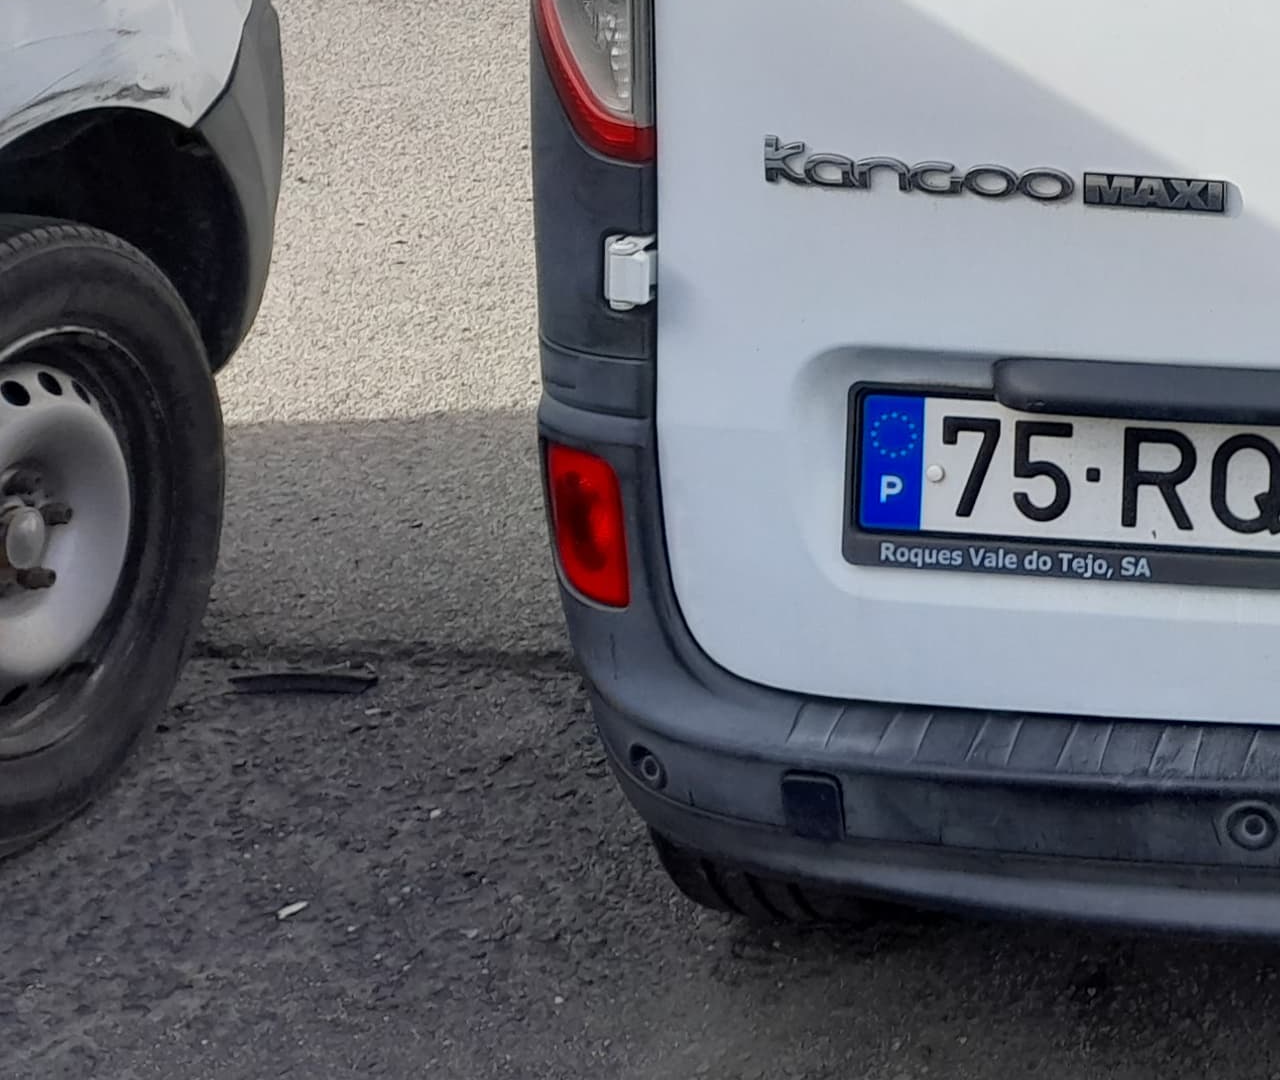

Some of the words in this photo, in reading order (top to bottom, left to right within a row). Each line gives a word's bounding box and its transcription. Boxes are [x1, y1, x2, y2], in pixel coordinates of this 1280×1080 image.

[1084, 172, 1227, 212] MAXI
[879, 474, 904, 504] P
[879, 541, 963, 568] Roques
[968, 547, 1018, 570] Vale
[1023, 551, 1052, 571] do
[1058, 552, 1114, 579] Tejo,
[1120, 556, 1151, 577] SA
